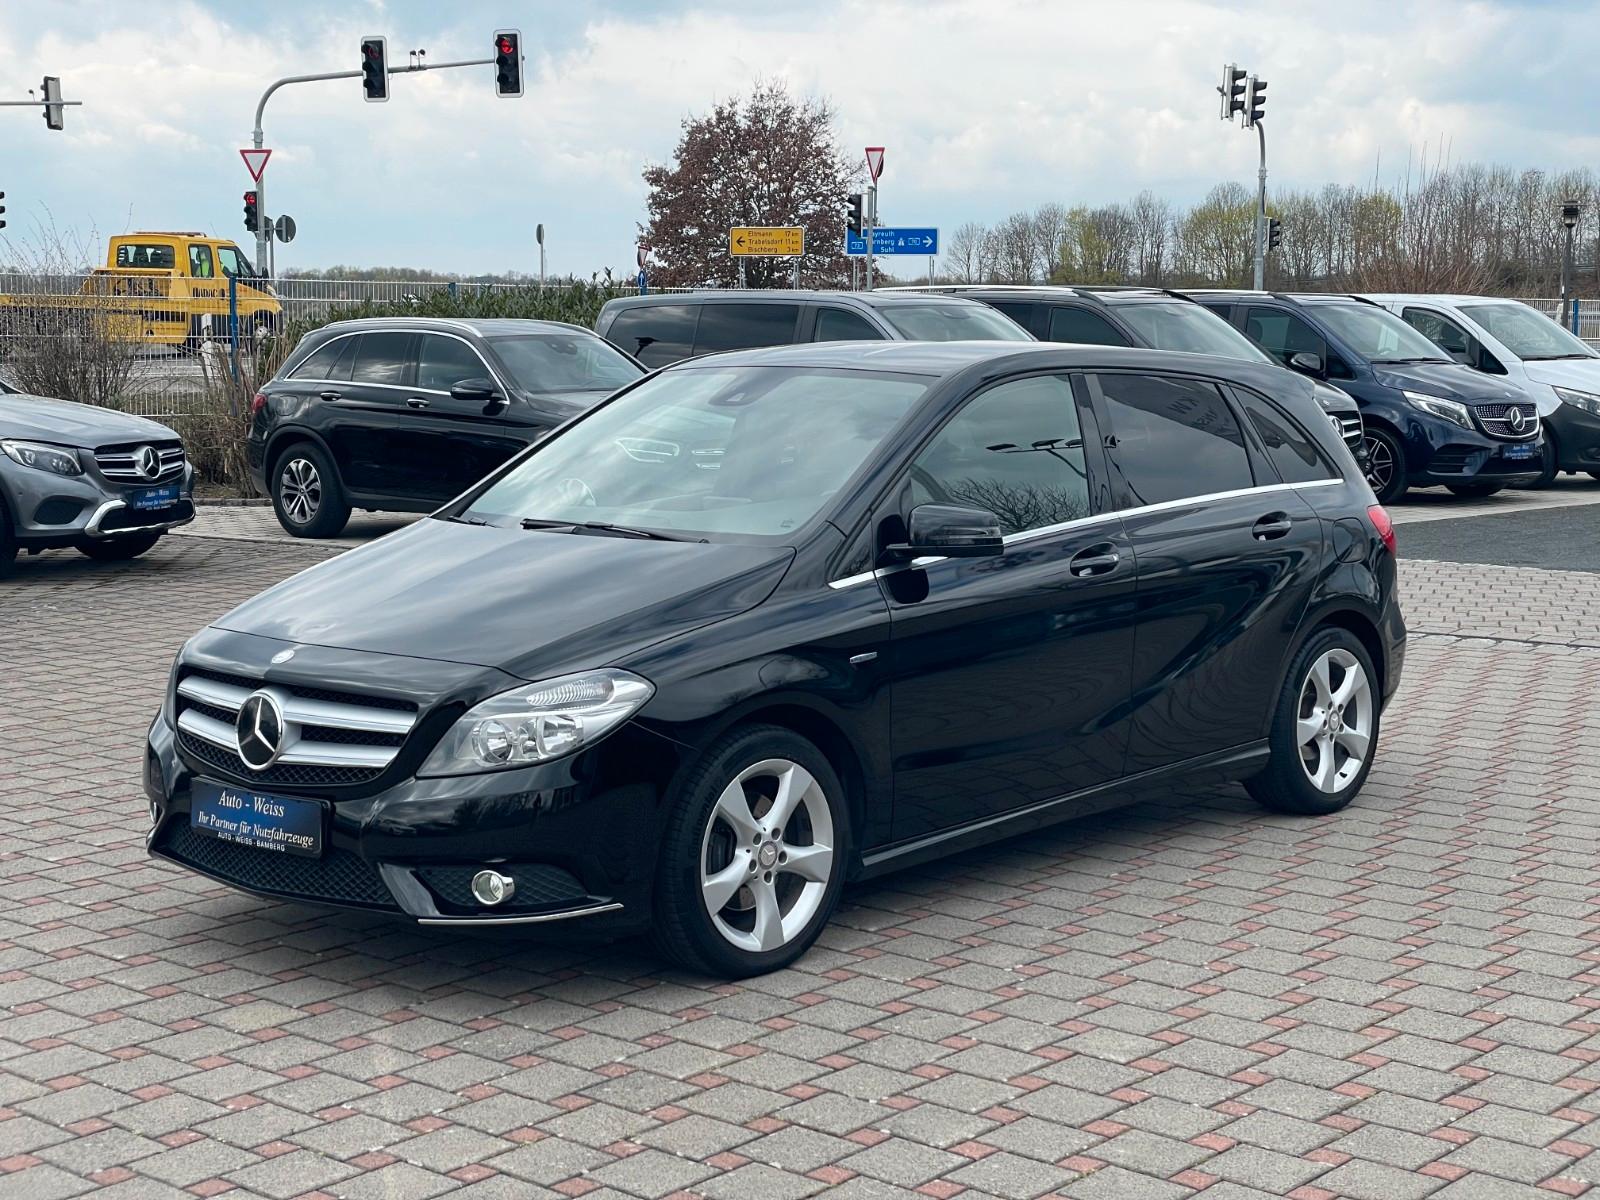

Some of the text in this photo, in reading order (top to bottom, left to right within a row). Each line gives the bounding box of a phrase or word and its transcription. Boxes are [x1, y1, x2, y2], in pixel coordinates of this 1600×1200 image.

[218, 790, 242, 810] Auto
[253, 796, 285, 817] Weiss
[198, 810, 314, 848] Ihr Partner für Nutzfahrzeuge
[217, 831, 232, 841] AUTO
[235, 835, 253, 846] WEISS
[256, 840, 285, 852] BAMBERG
